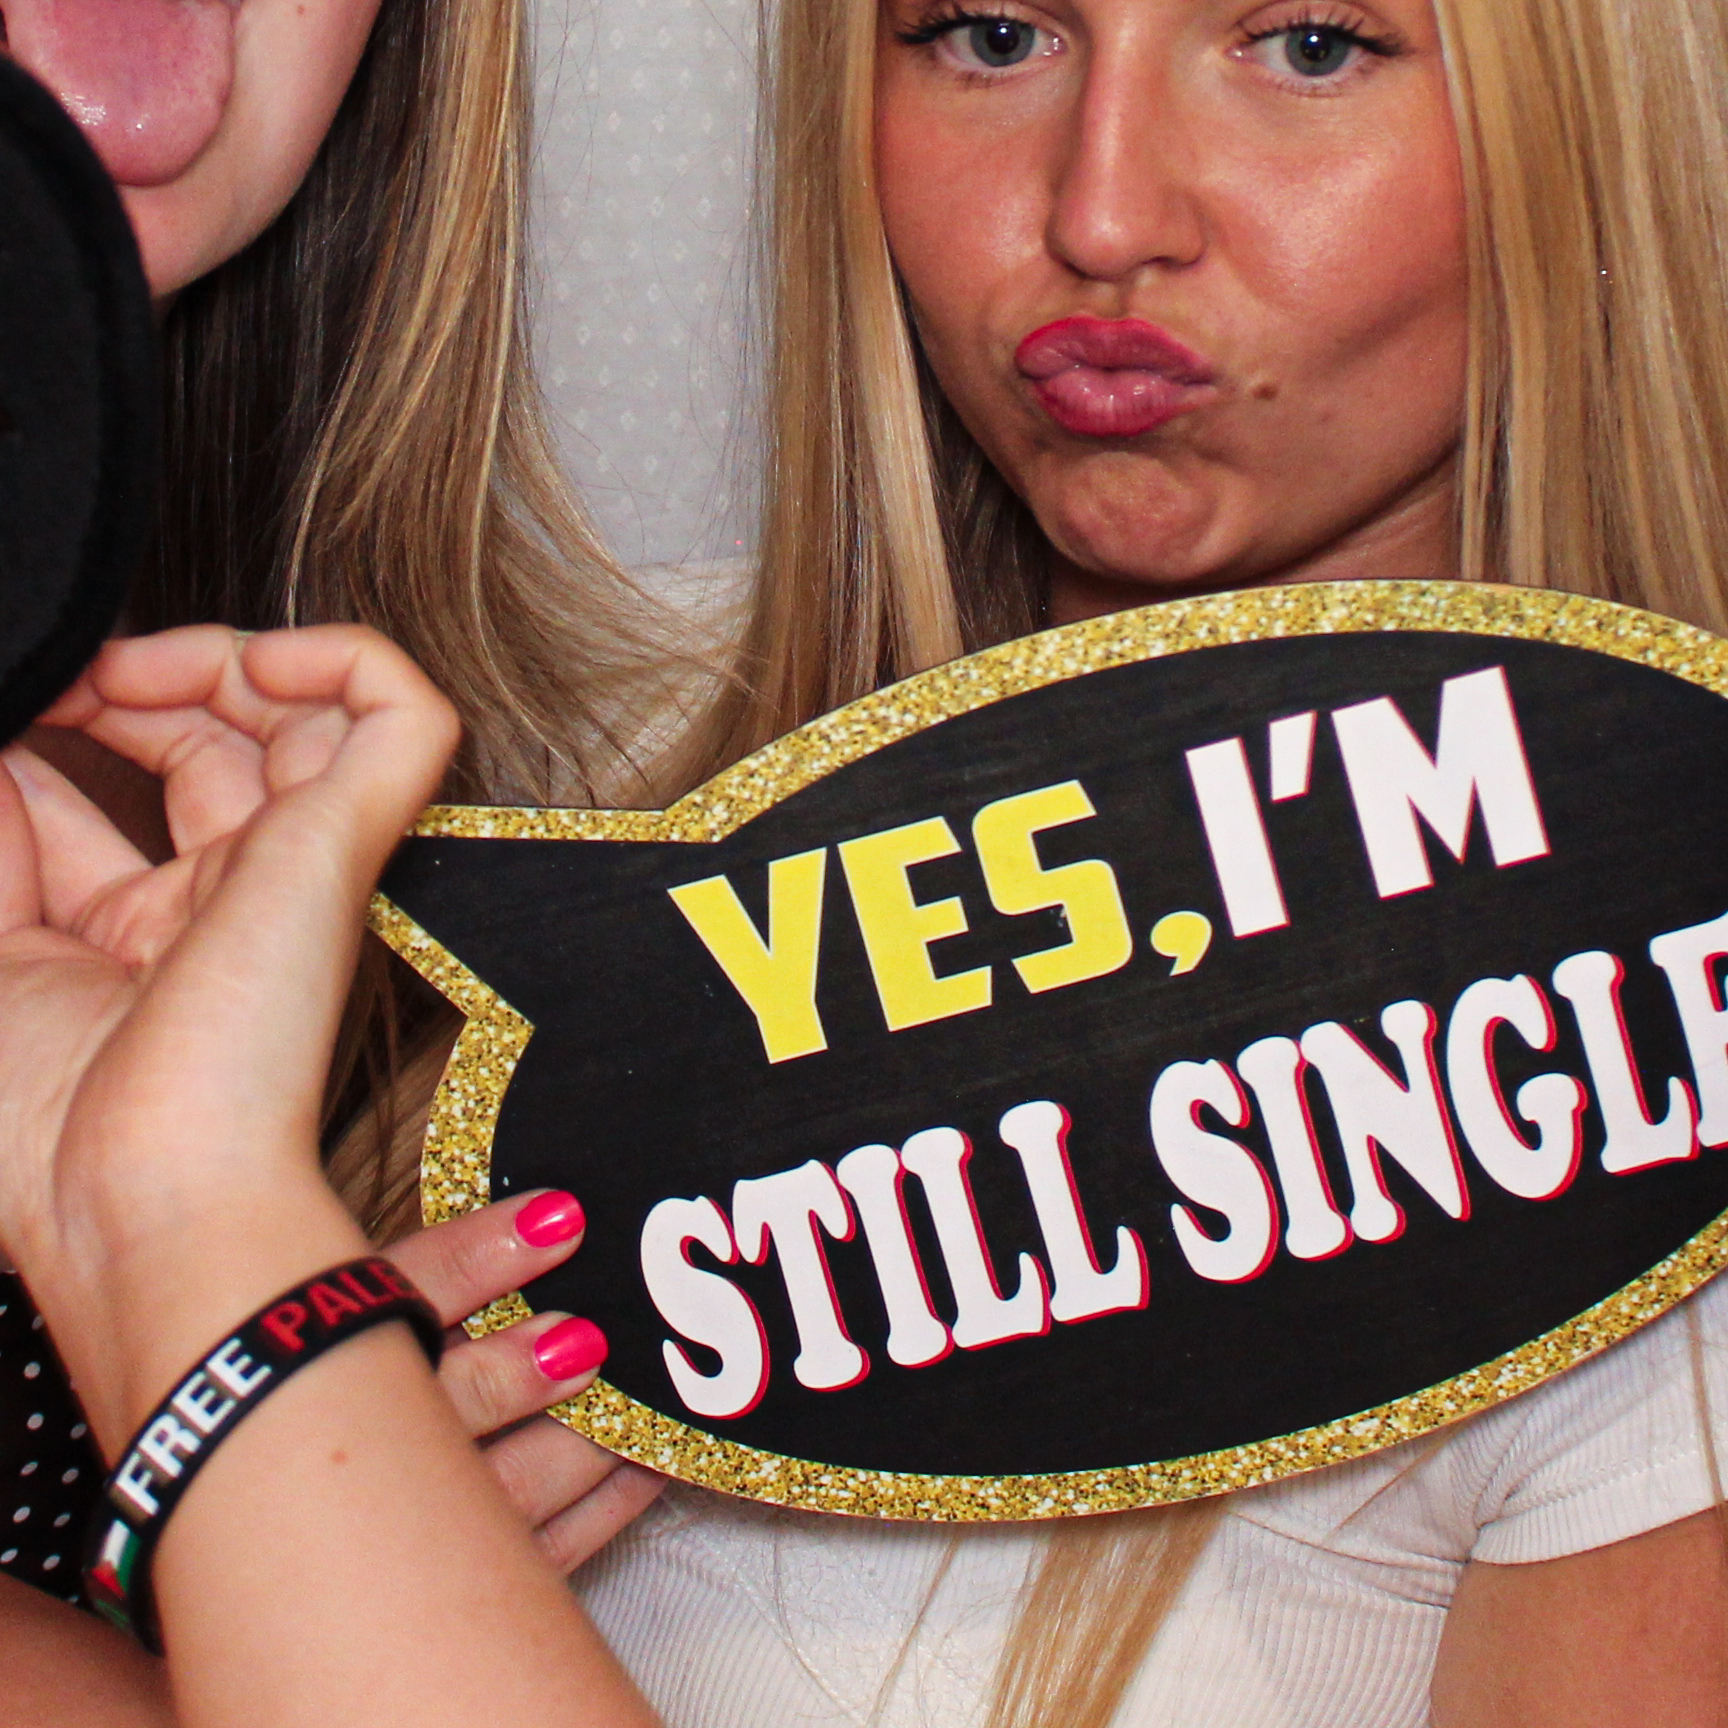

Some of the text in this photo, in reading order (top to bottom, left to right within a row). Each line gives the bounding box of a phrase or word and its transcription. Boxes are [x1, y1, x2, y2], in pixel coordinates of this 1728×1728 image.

[668, 667, 1551, 1063] YES, I'M
[640, 1101, 1149, 1417] STILL
[115, 1337, 271, 1516] FREE
